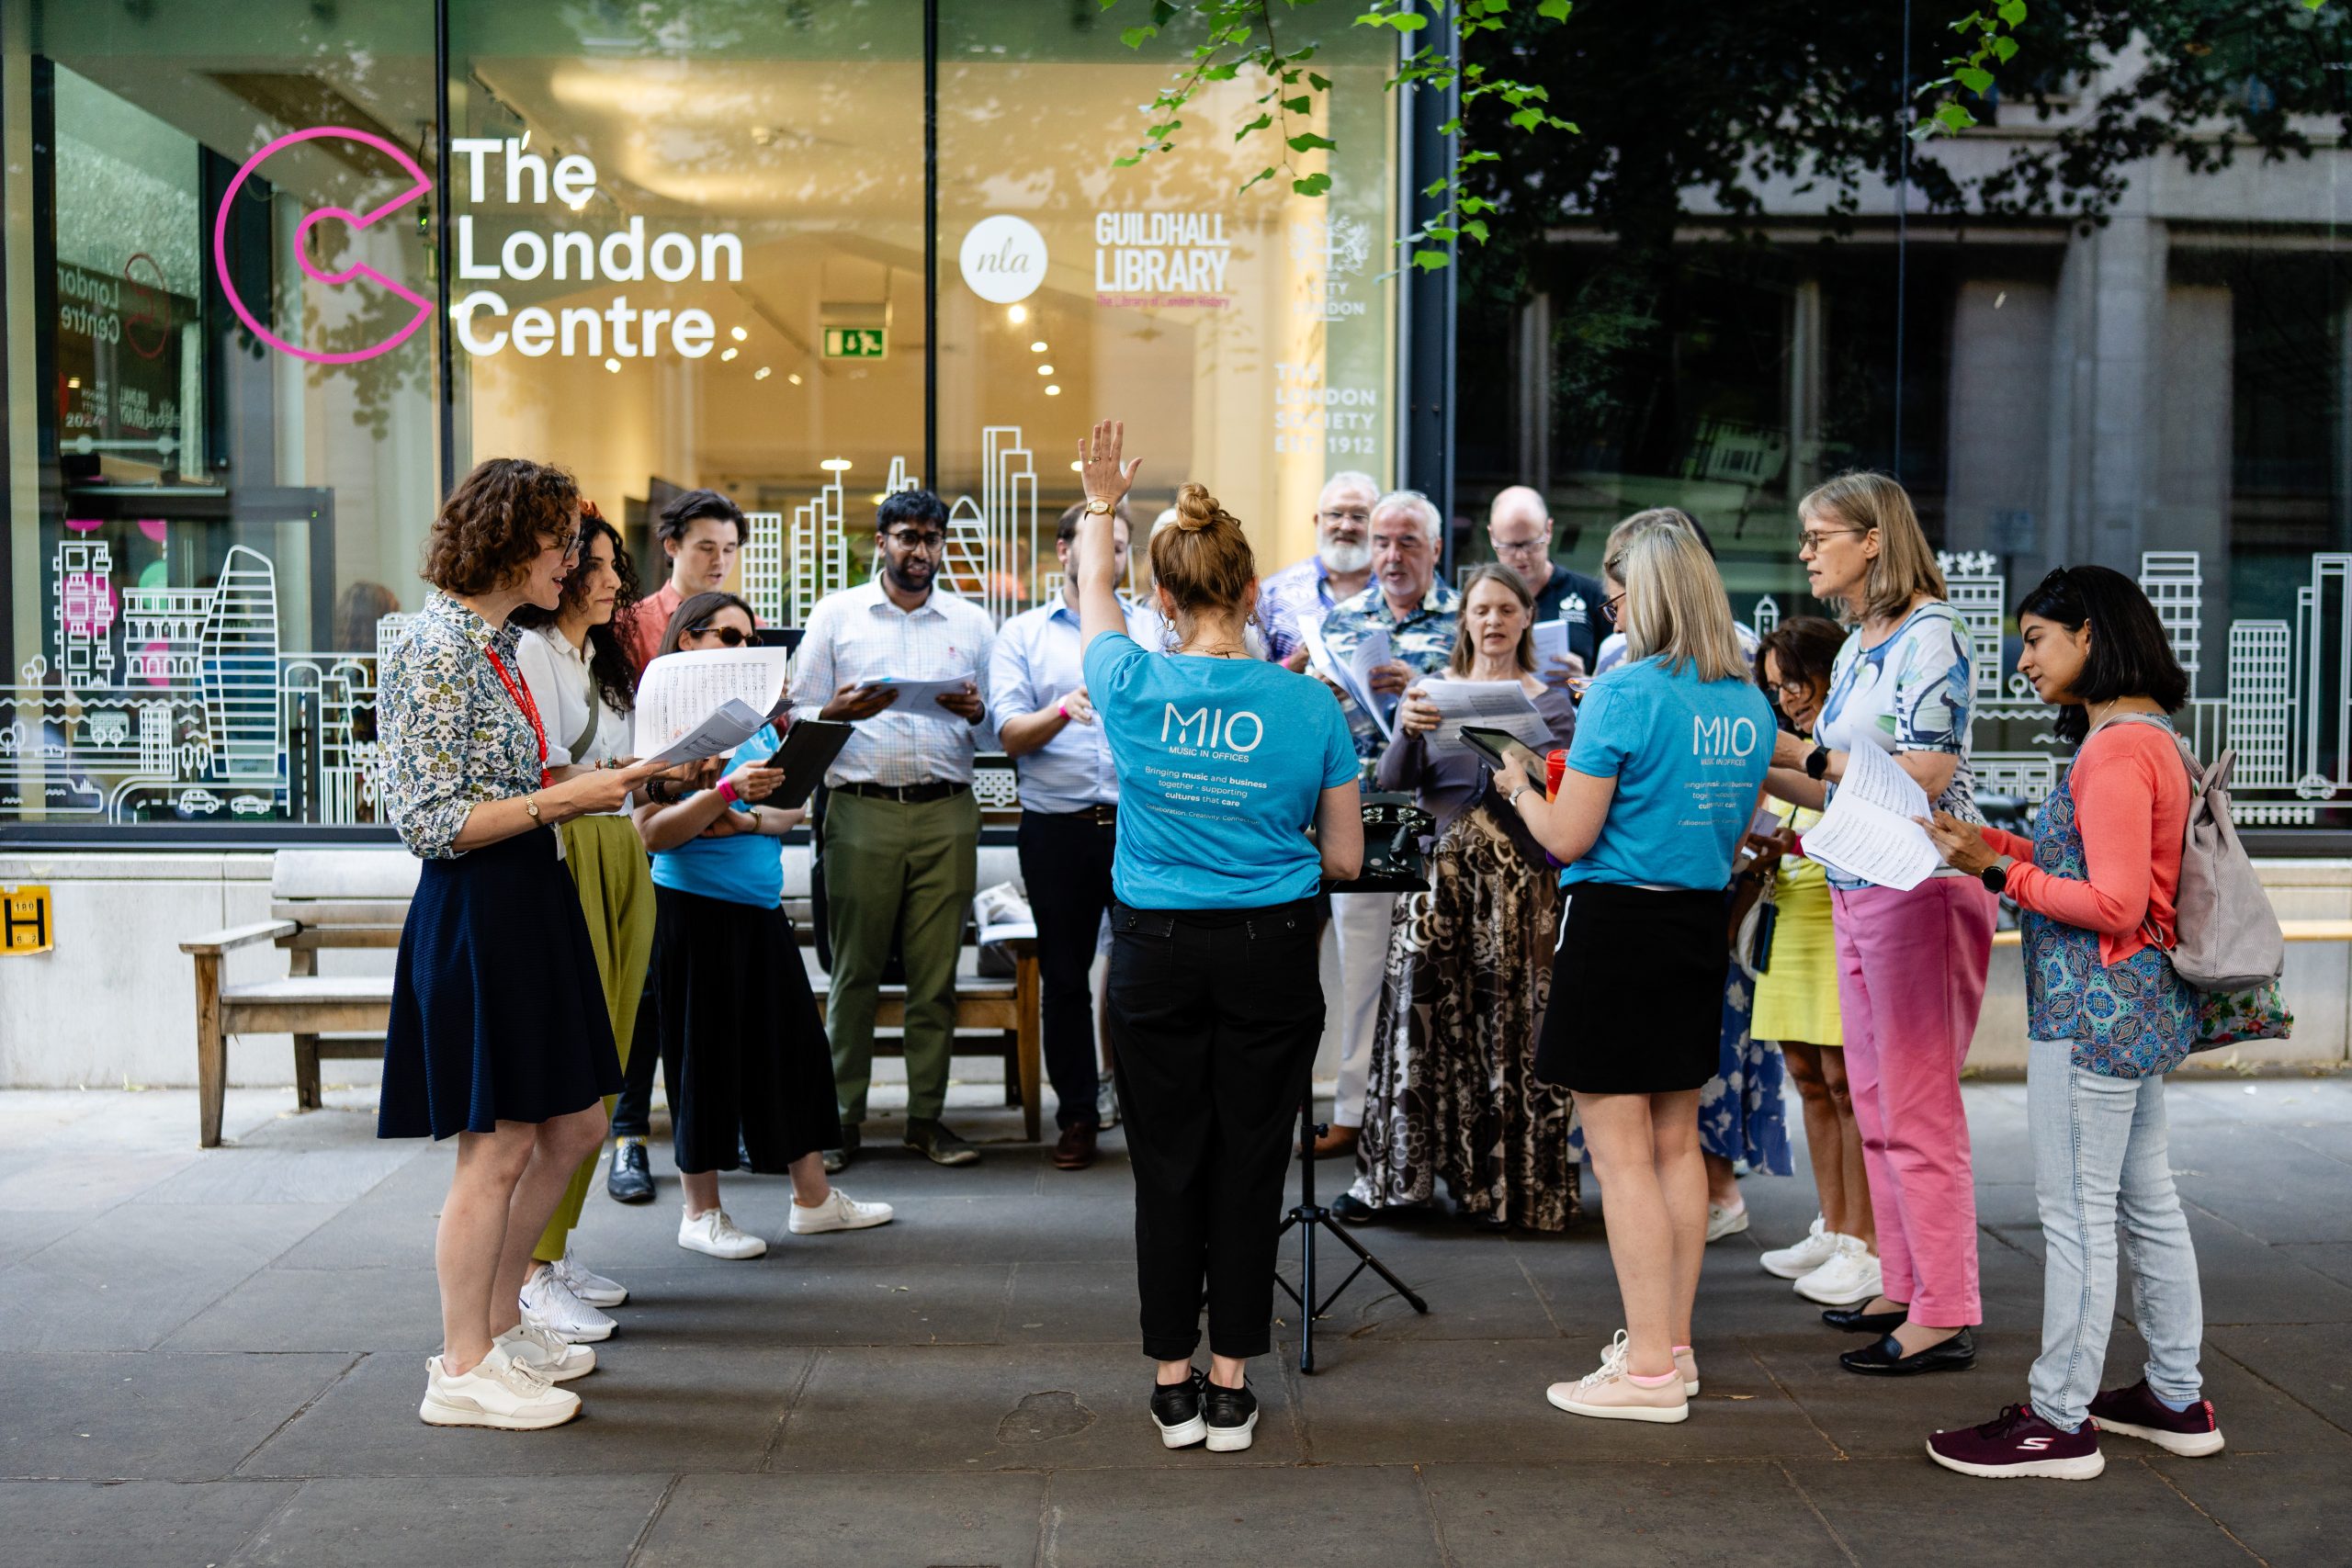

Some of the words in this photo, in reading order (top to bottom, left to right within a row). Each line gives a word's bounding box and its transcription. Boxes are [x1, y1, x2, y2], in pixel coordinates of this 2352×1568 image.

[451, 137, 597, 205] The
[1095, 212, 1230, 246] GUILDHALL
[458, 214, 742, 282] London
[977, 236, 1030, 274] nla
[1095, 249, 1230, 292] LIBRARY
[457, 290, 716, 358] Centre
[1274, 363, 1319, 381] THE
[1275, 387, 1376, 406] LONDON
[1274, 412, 1375, 430] SOCIETY
[1328, 436, 1374, 454] 1912
[1160, 702, 1263, 752] MIO
[1692, 715, 1757, 757] MIO
[1169, 746, 1197, 757] MUSIC
[1200, 750, 1209, 758] IN
[1212, 751, 1250, 763] OFFICES
[1145, 765, 1180, 779] Bringing
[1182, 772, 1209, 781] music
[1210, 774, 1227, 784] and
[1229, 777, 1268, 789] business
[1159, 780, 1194, 791] together
[1201, 785, 1248, 798] supporting
[1165, 792, 1201, 802] cultures
[1202, 795, 1219, 805] that
[1221, 798, 1240, 807] care
[4, 897, 46, 949] H
